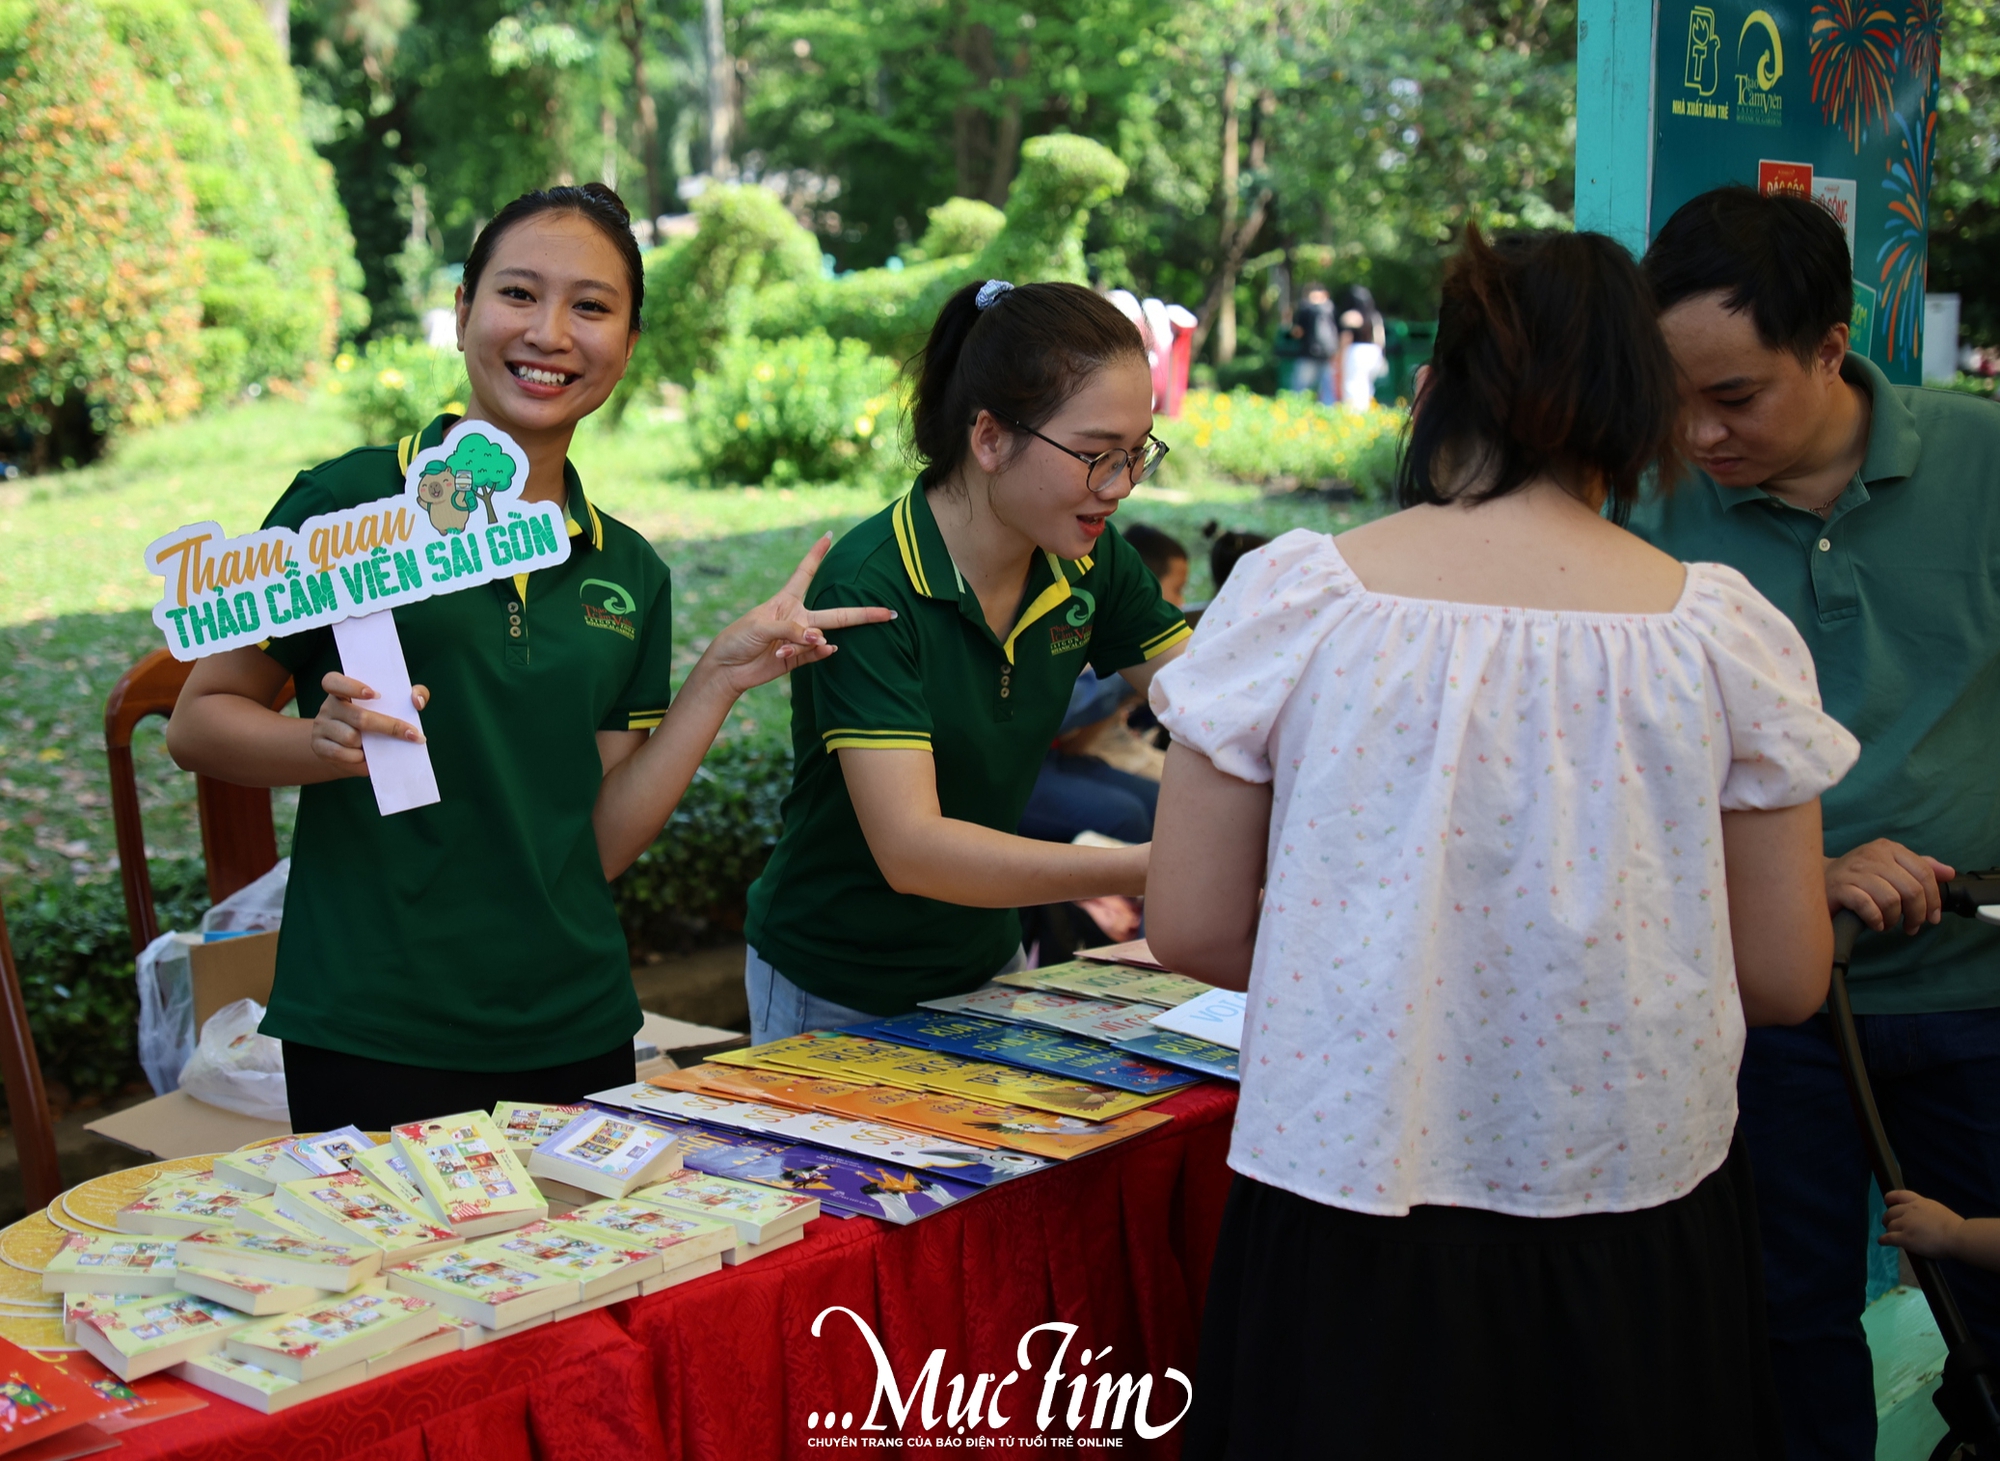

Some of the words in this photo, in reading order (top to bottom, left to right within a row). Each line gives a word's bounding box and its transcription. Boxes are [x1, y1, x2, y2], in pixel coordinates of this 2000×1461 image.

[1672, 98, 1685, 115] NHÀ
[1687, 98, 1702, 117] XUẤT
[1718, 101, 1729, 120] TRẺ
[156, 533, 295, 608] Tham
[308, 507, 416, 573] quan
[165, 586, 260, 649] THẢO
[264, 560, 338, 625] CẦM
[339, 546, 422, 605] VIÊN
[425, 527, 483, 582] SÀI
[485, 511, 559, 567] GÒN
[1026, 1046, 1090, 1062] RÙA
